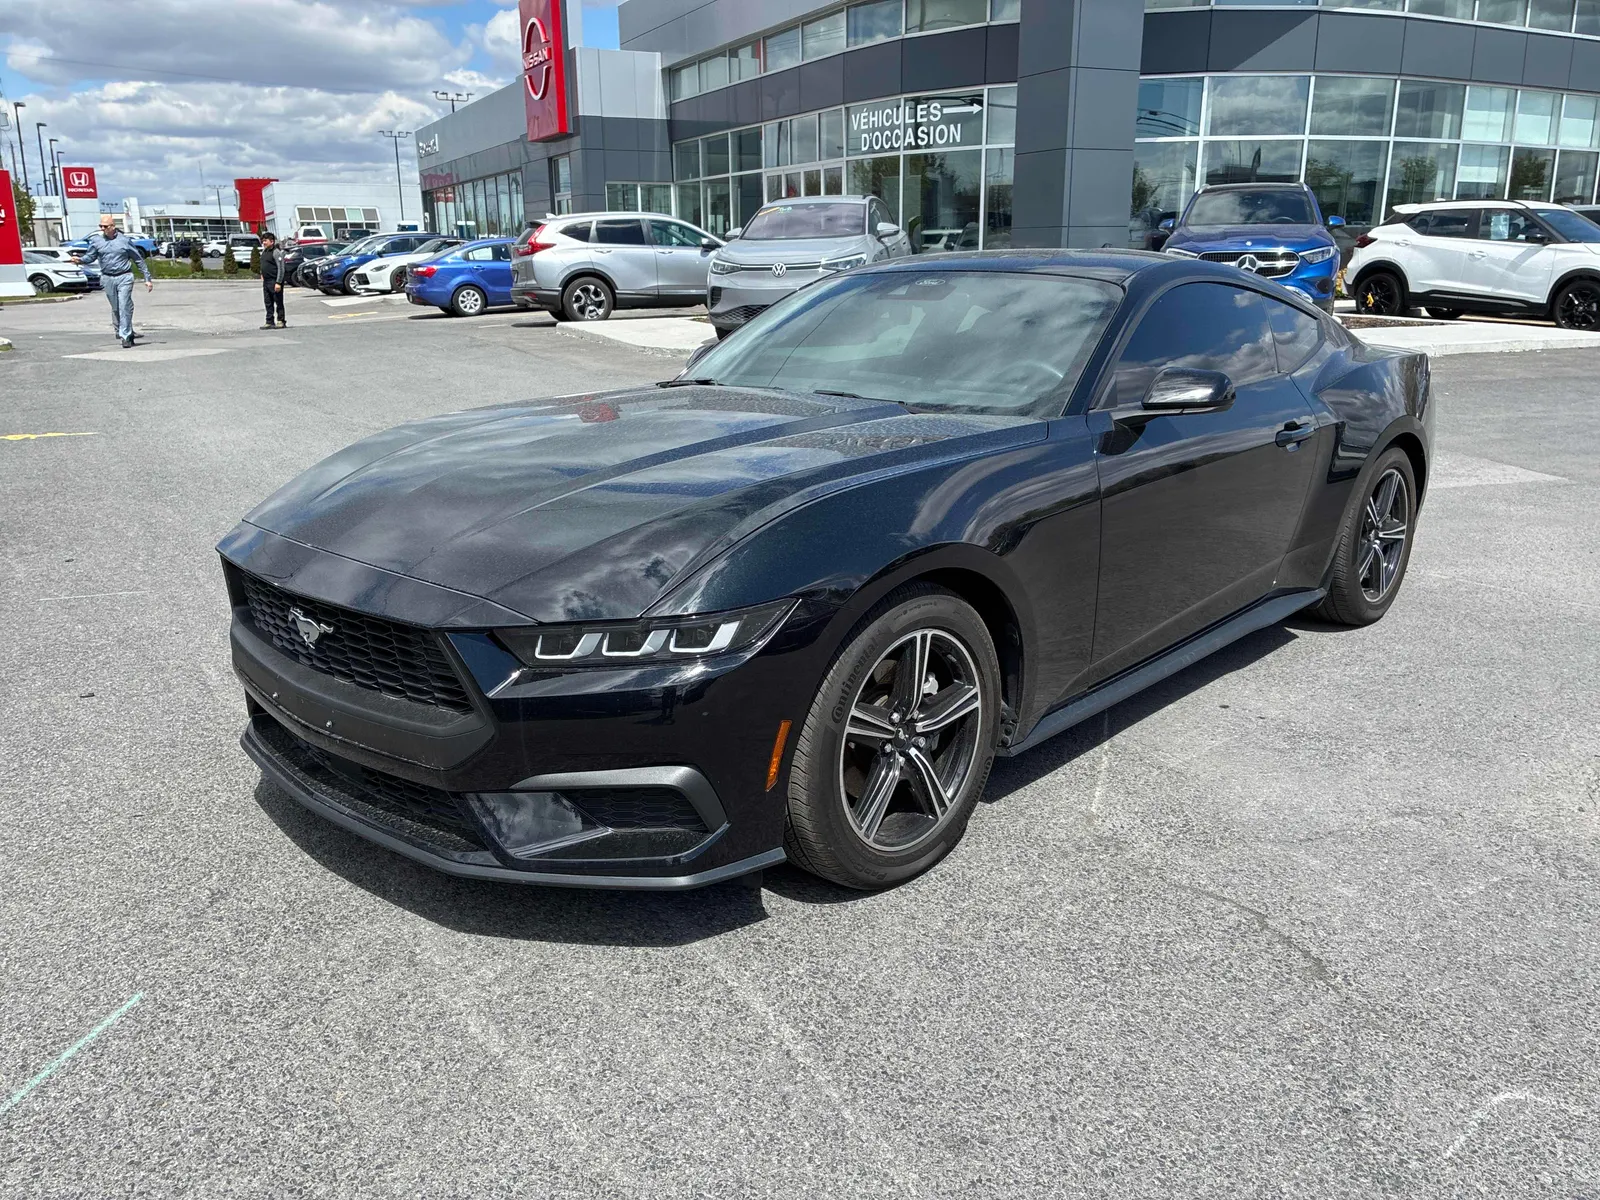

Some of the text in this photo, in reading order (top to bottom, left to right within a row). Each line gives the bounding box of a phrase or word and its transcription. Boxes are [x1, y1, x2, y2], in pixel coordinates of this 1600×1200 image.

[523, 46, 549, 70] NISSAN
[852, 102, 942, 131] VÉHICULES
[861, 123, 961, 151] D'OCCASION
[831, 636, 879, 723] Continental
